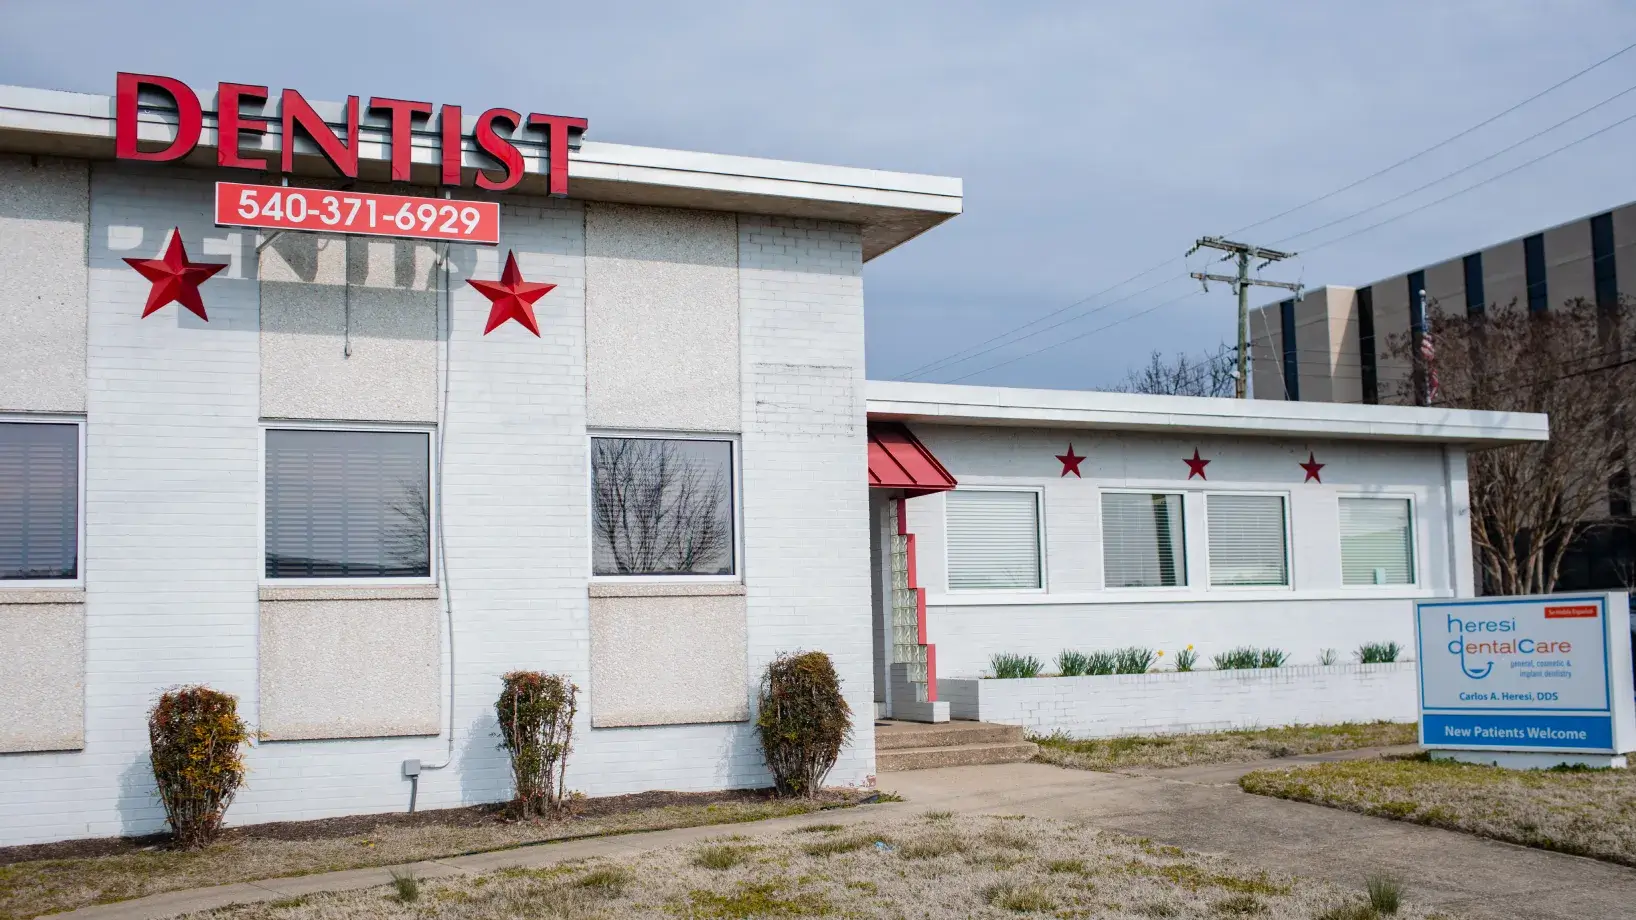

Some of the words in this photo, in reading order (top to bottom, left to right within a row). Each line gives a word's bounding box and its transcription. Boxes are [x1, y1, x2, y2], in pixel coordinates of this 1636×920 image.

[115, 71, 588, 198] DENTIST
[237, 190, 481, 235] 540-371-6929
[1447, 614, 1516, 633] heresi
[1448, 635, 1572, 664] dentalCare
[1510, 660, 1534, 668] general,
[1519, 670, 1542, 678] implant
[1544, 670, 1572, 678] dentistry
[1459, 692, 1488, 701] Carlos
[1490, 692, 1500, 701] A.
[1502, 692, 1534, 702] Heresi,
[1537, 692, 1559, 701] DDS
[1444, 726, 1471, 737] New
[1474, 726, 1525, 738] Patients
[1527, 727, 1587, 740] Welcome
